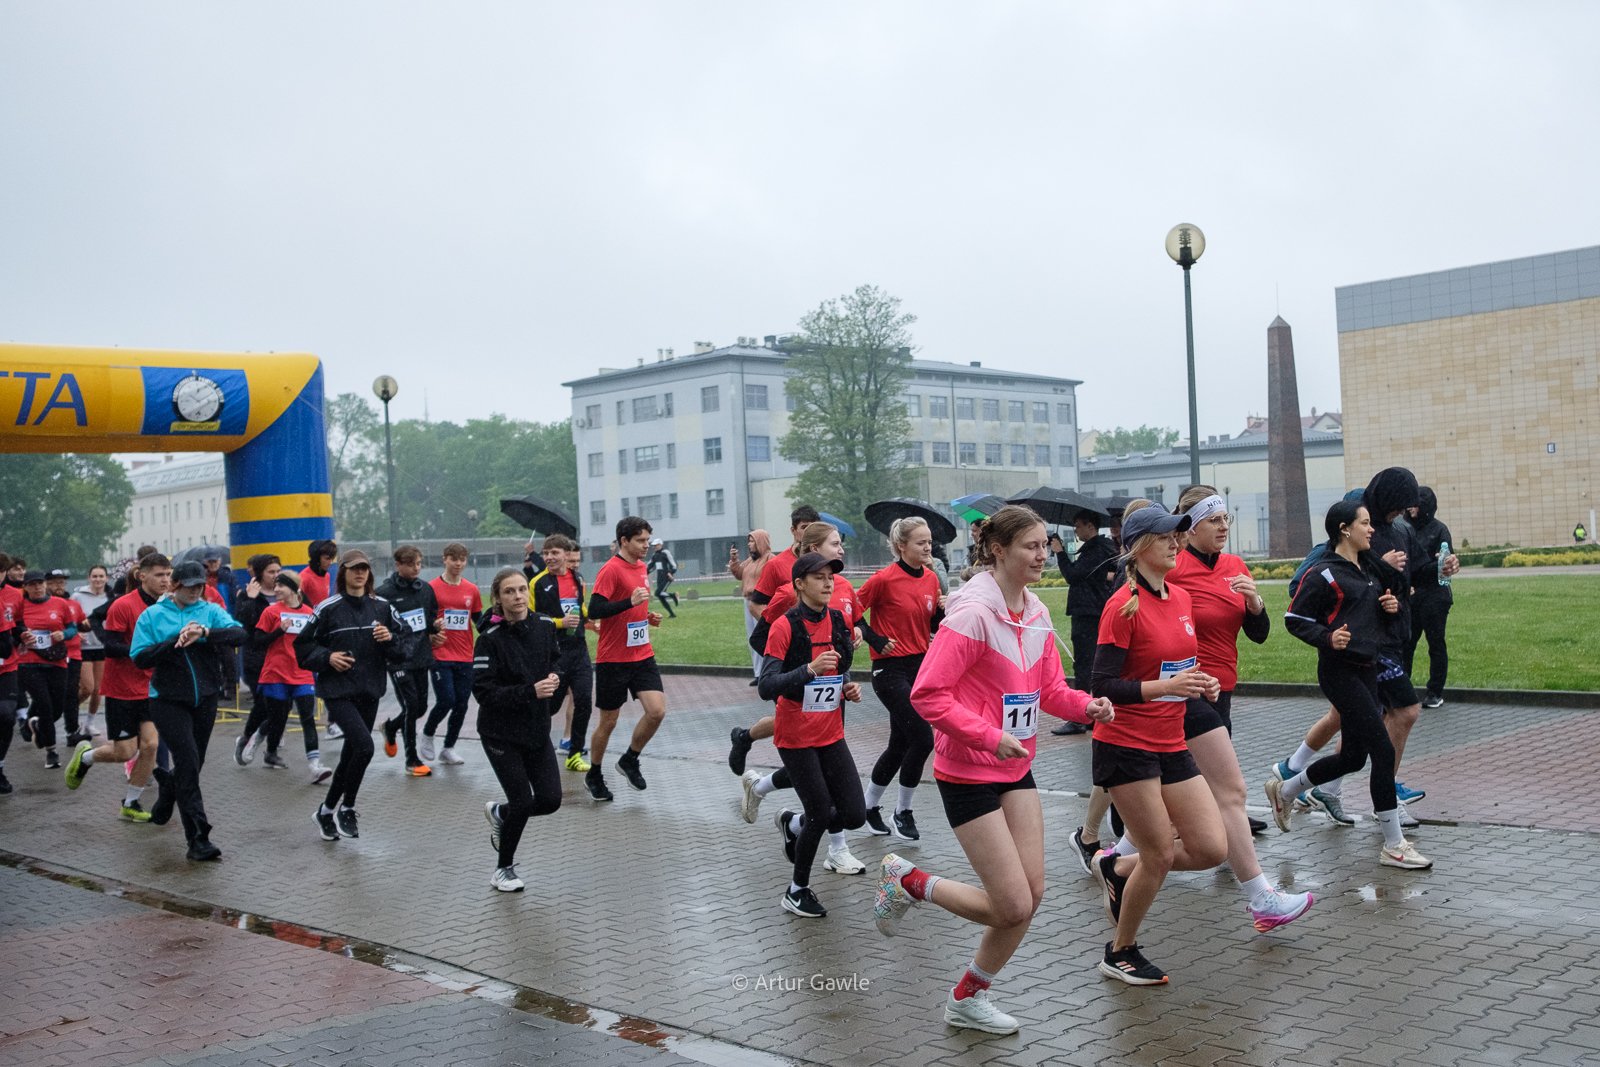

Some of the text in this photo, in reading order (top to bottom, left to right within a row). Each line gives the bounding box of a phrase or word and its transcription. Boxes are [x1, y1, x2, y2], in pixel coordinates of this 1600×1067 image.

[0, 371, 88, 427] TA
[410, 615, 423, 625] 15
[446, 615, 465, 625] 138
[632, 628, 645, 640] 90
[813, 687, 835, 703] 72
